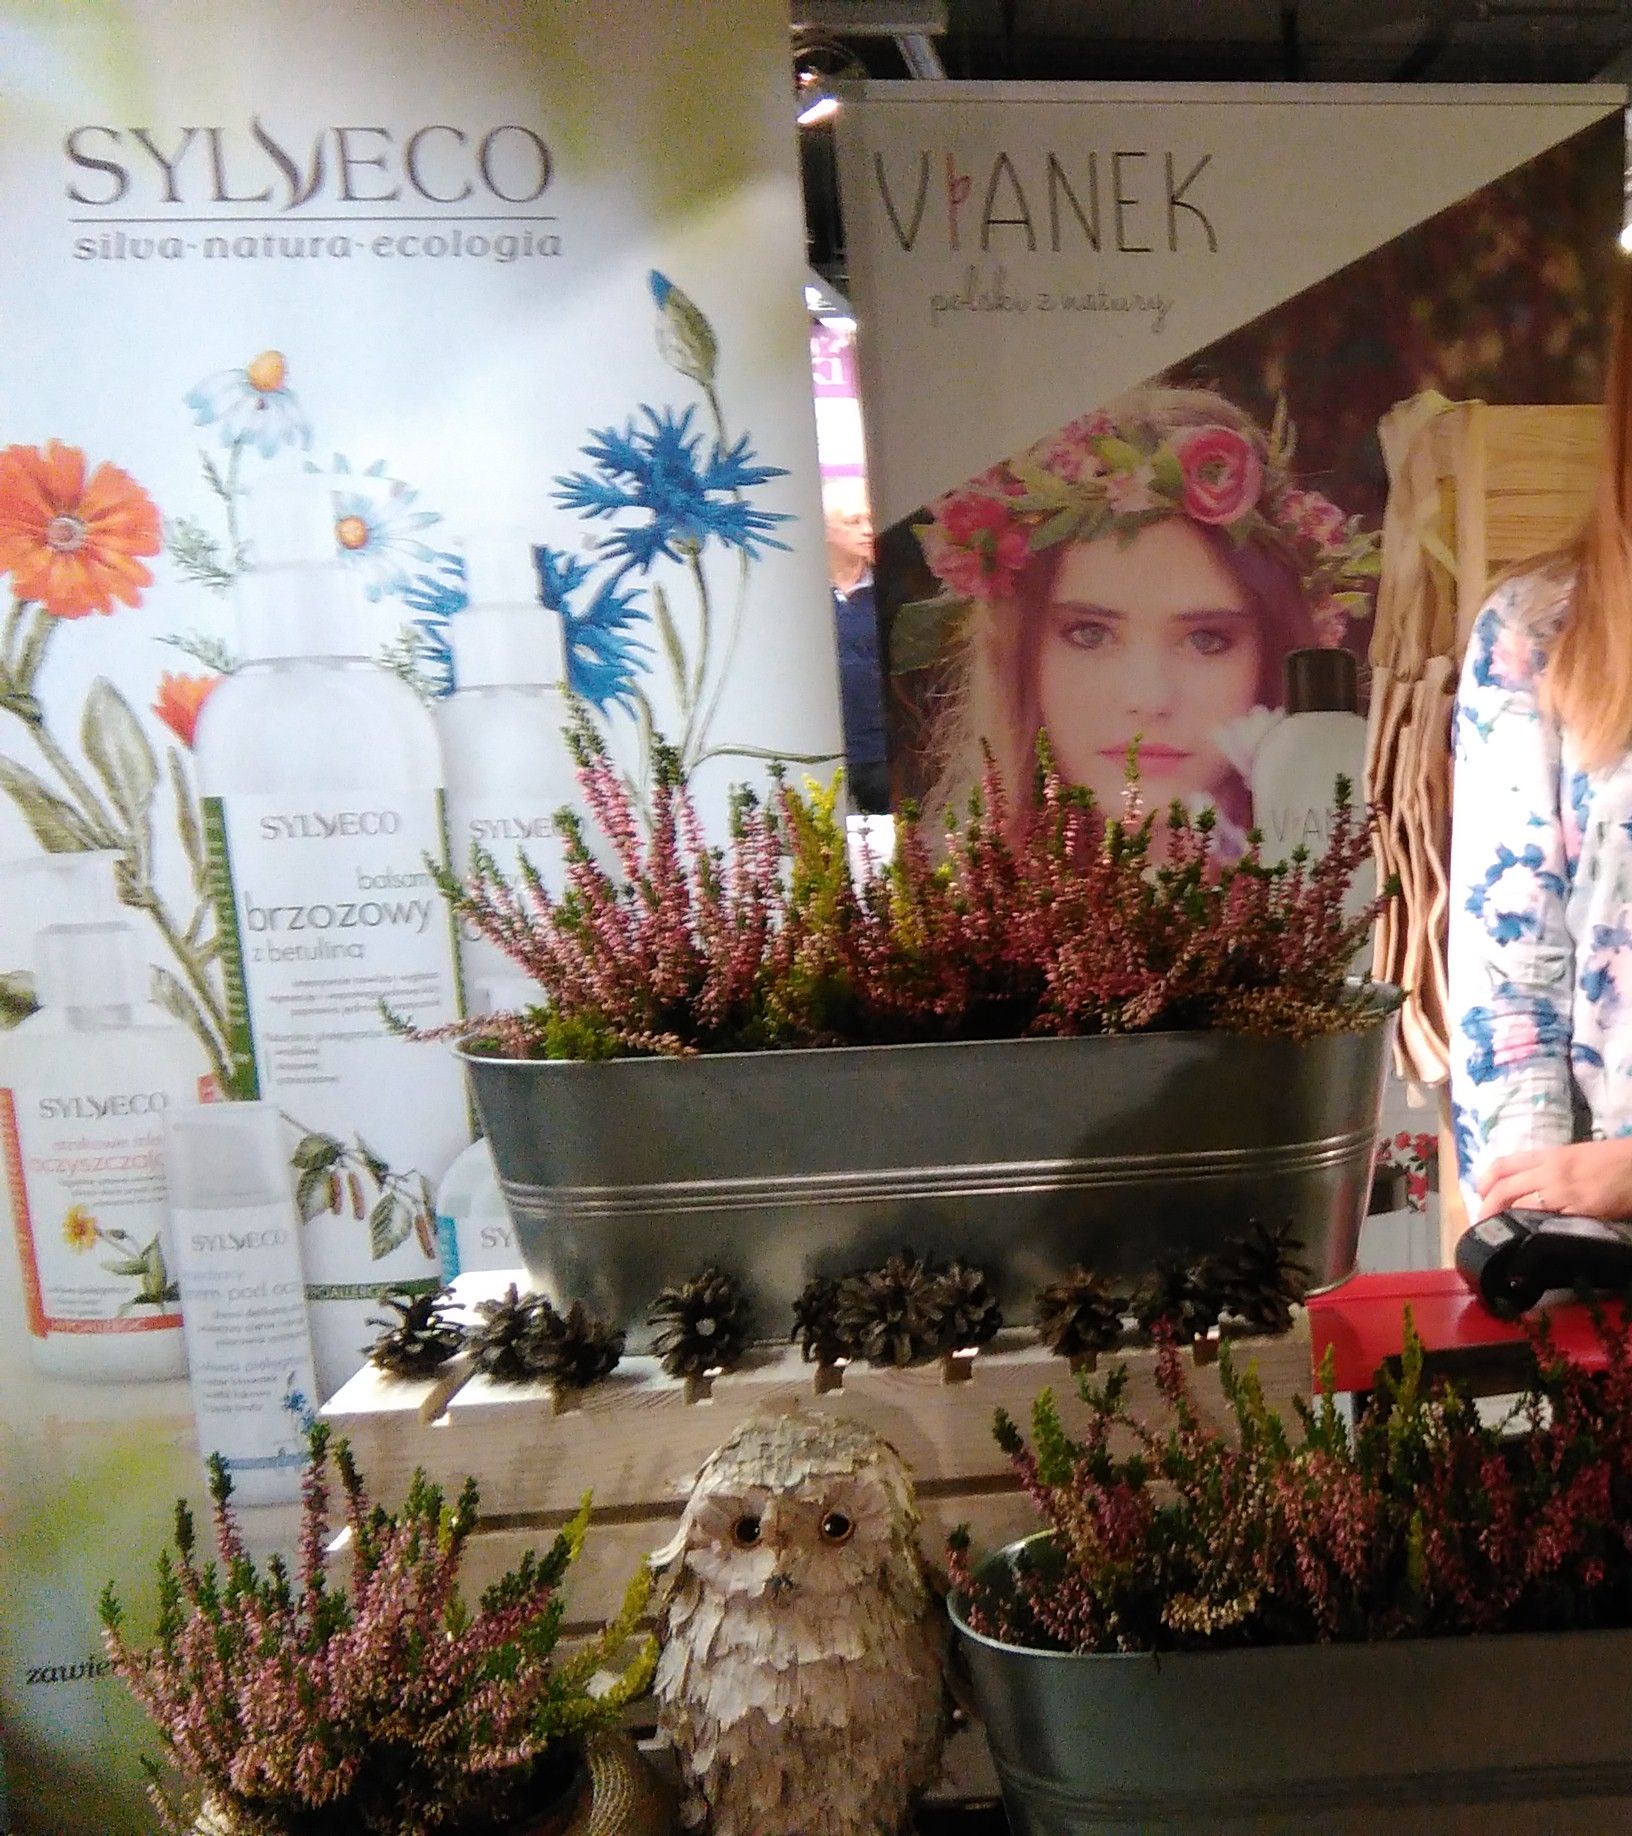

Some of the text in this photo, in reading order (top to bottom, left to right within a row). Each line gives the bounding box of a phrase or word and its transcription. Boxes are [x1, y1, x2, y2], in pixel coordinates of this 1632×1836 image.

[63, 115, 556, 211] SYLVECO
[874, 150, 1220, 253] VIANEK
[260, 810, 400, 840] SYLVECO
[245, 890, 431, 934] brzozowy
[39, 1091, 168, 1121] SYLVECO
[192, 1229, 287, 1252] SYLVECO
